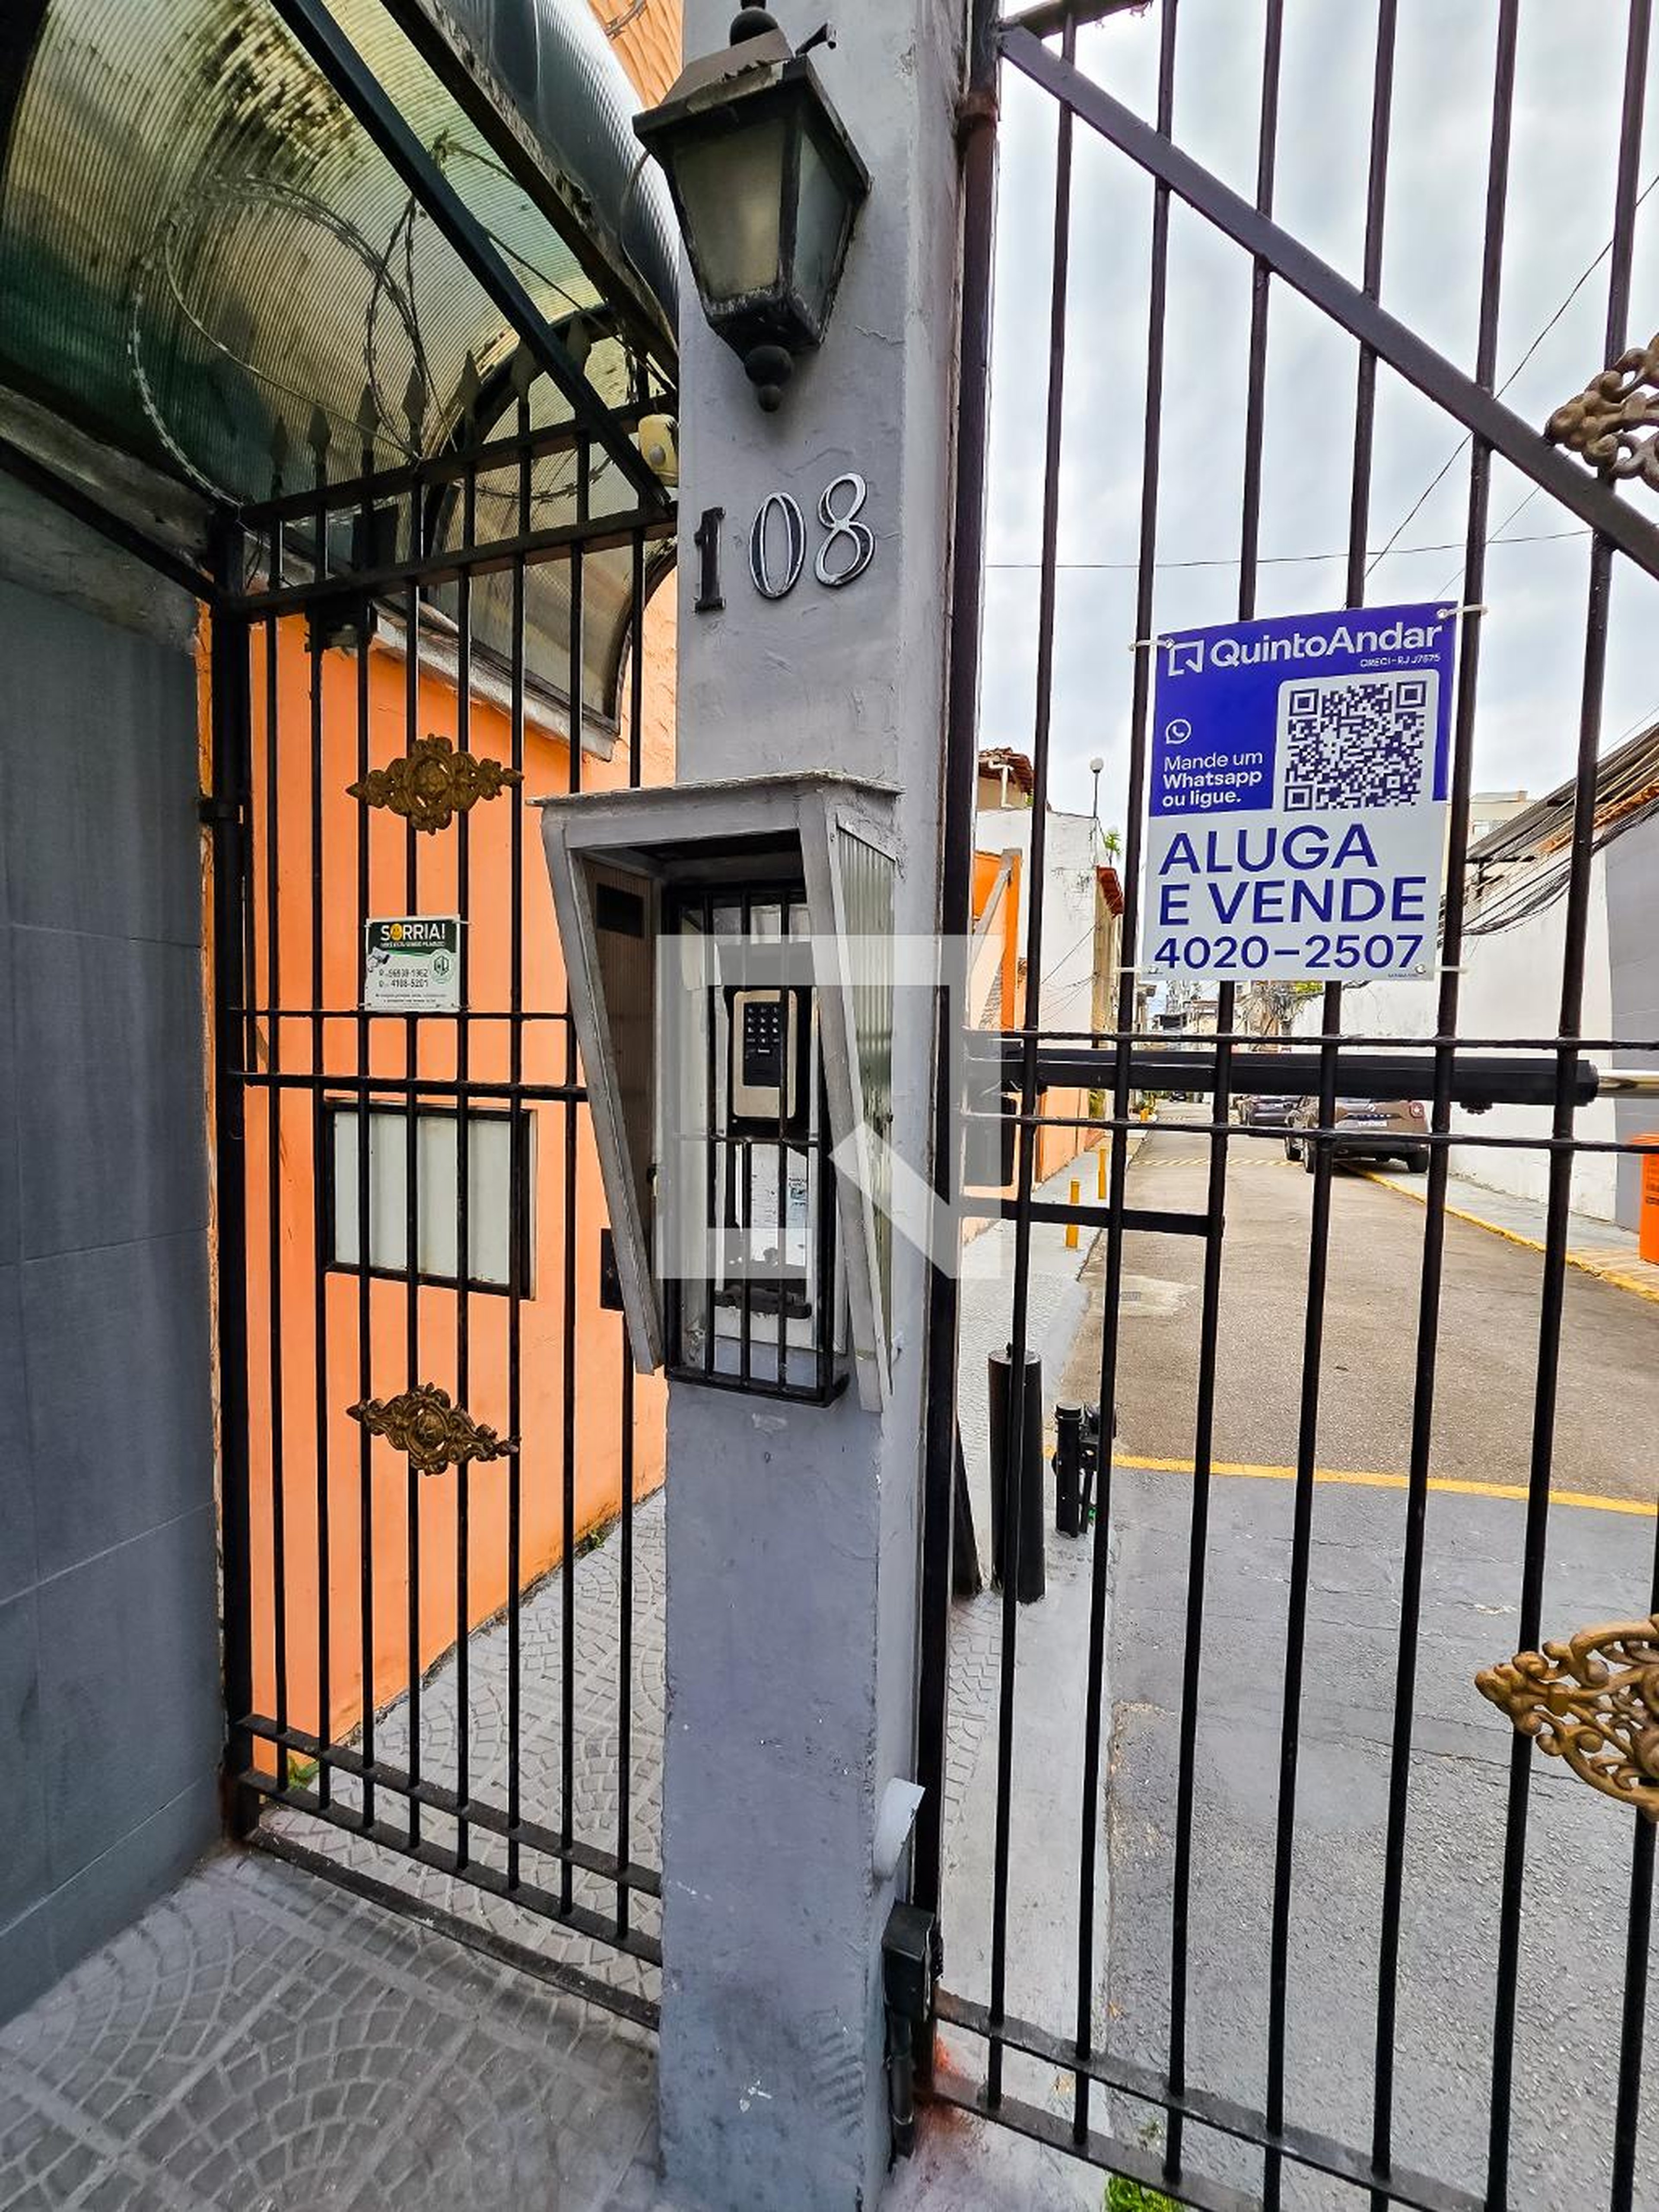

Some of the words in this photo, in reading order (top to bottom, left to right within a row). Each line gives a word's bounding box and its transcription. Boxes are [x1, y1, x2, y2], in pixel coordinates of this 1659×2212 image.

[693, 472, 875, 614] 108
[1210, 622, 1442, 668] QuintoAndar
[1164, 753, 1228, 772] Mande
[1233, 752, 1263, 765] um
[1163, 771, 1262, 789] Whatsapp
[1162, 795, 1185, 807] ou
[1190, 790, 1242, 808] ligue.
[1159, 824, 1378, 875] ALUGA
[1160, 884, 1190, 926] E
[1207, 876, 1426, 924] VENDE
[381, 923, 445, 941] SORRIA!
[1154, 934, 1423, 969] 4020-2507
